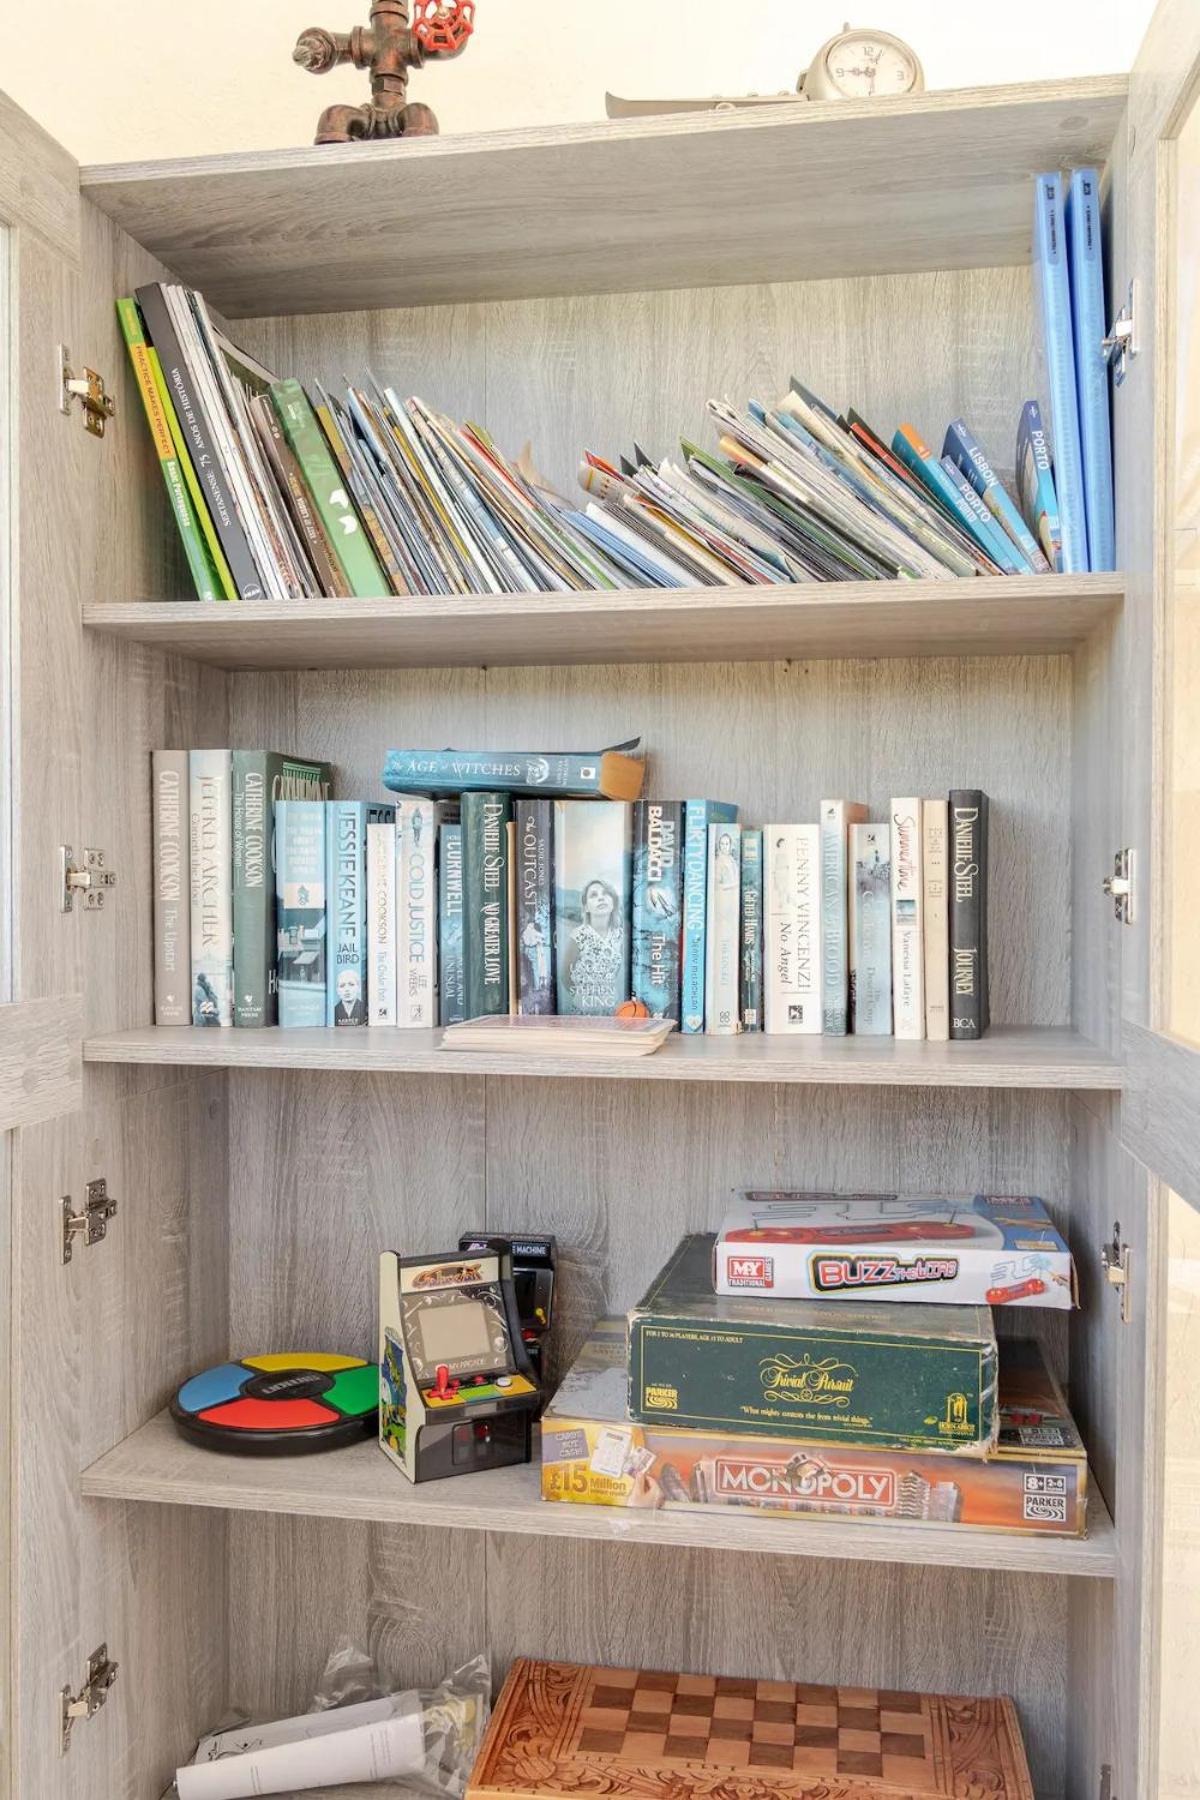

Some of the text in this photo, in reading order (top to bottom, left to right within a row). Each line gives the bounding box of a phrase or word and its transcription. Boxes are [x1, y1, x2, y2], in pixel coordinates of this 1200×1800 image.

[863, 46, 875, 57] 12
[835, 67, 845, 78] 9
[896, 70, 905, 81] 3
[135, 345, 171, 454] PRACTICE MAKES PERFECT
[185, 410, 195, 423] DE
[200, 454, 212, 468] 75
[967, 446, 999, 487] LISBON
[1031, 430, 1050, 471] PORTO
[960, 483, 992, 524] PORTO
[407, 760, 438, 773] AGE
[451, 760, 521, 781] WITCHES
[159, 771, 180, 901] CATHERINE COOKSON
[245, 772, 263, 888] CATHERINE COOKSON
[647, 805, 663, 882] BALDACCI
[661, 820, 676, 868] DAVID
[339, 810, 356, 938] JESSIE KEANE
[524, 833, 537, 909] OUTCAST
[687, 805, 705, 930] FLIRTY DANCING
[201, 857, 220, 947] ARCHER
[407, 853, 425, 963] COLD JUSTICE
[480, 803, 505, 985] DANIELLE STEEL NO GREATER LOVE
[795, 836, 812, 990] PENNY VINCENZI
[953, 807, 979, 996] DANIELLE STEEL JOURNEY
[378, 890, 389, 944] COOKSON
[163, 908, 178, 972] The Upstart
[335, 953, 360, 965] BIRD
[336, 943, 356, 953] JAIL
[651, 933, 666, 985] The Hit
[777, 922, 793, 985] No Angel
[901, 930, 912, 969] Vanessa
[582, 995, 616, 1007] KING
[952, 1018, 975, 1029] BCA
[515, 1245, 547, 1255] MACHINE
[731, 1260, 764, 1277] MY
[819, 1260, 897, 1288] BUZZ
[645, 1386, 678, 1398] PARKER
[759, 1364, 855, 1393] Trivial Pursuit
[550, 1464, 627, 1493] £15 Million
[721, 1465, 889, 1501] MONOPOLY
[1025, 1496, 1065, 1508] PARKER
